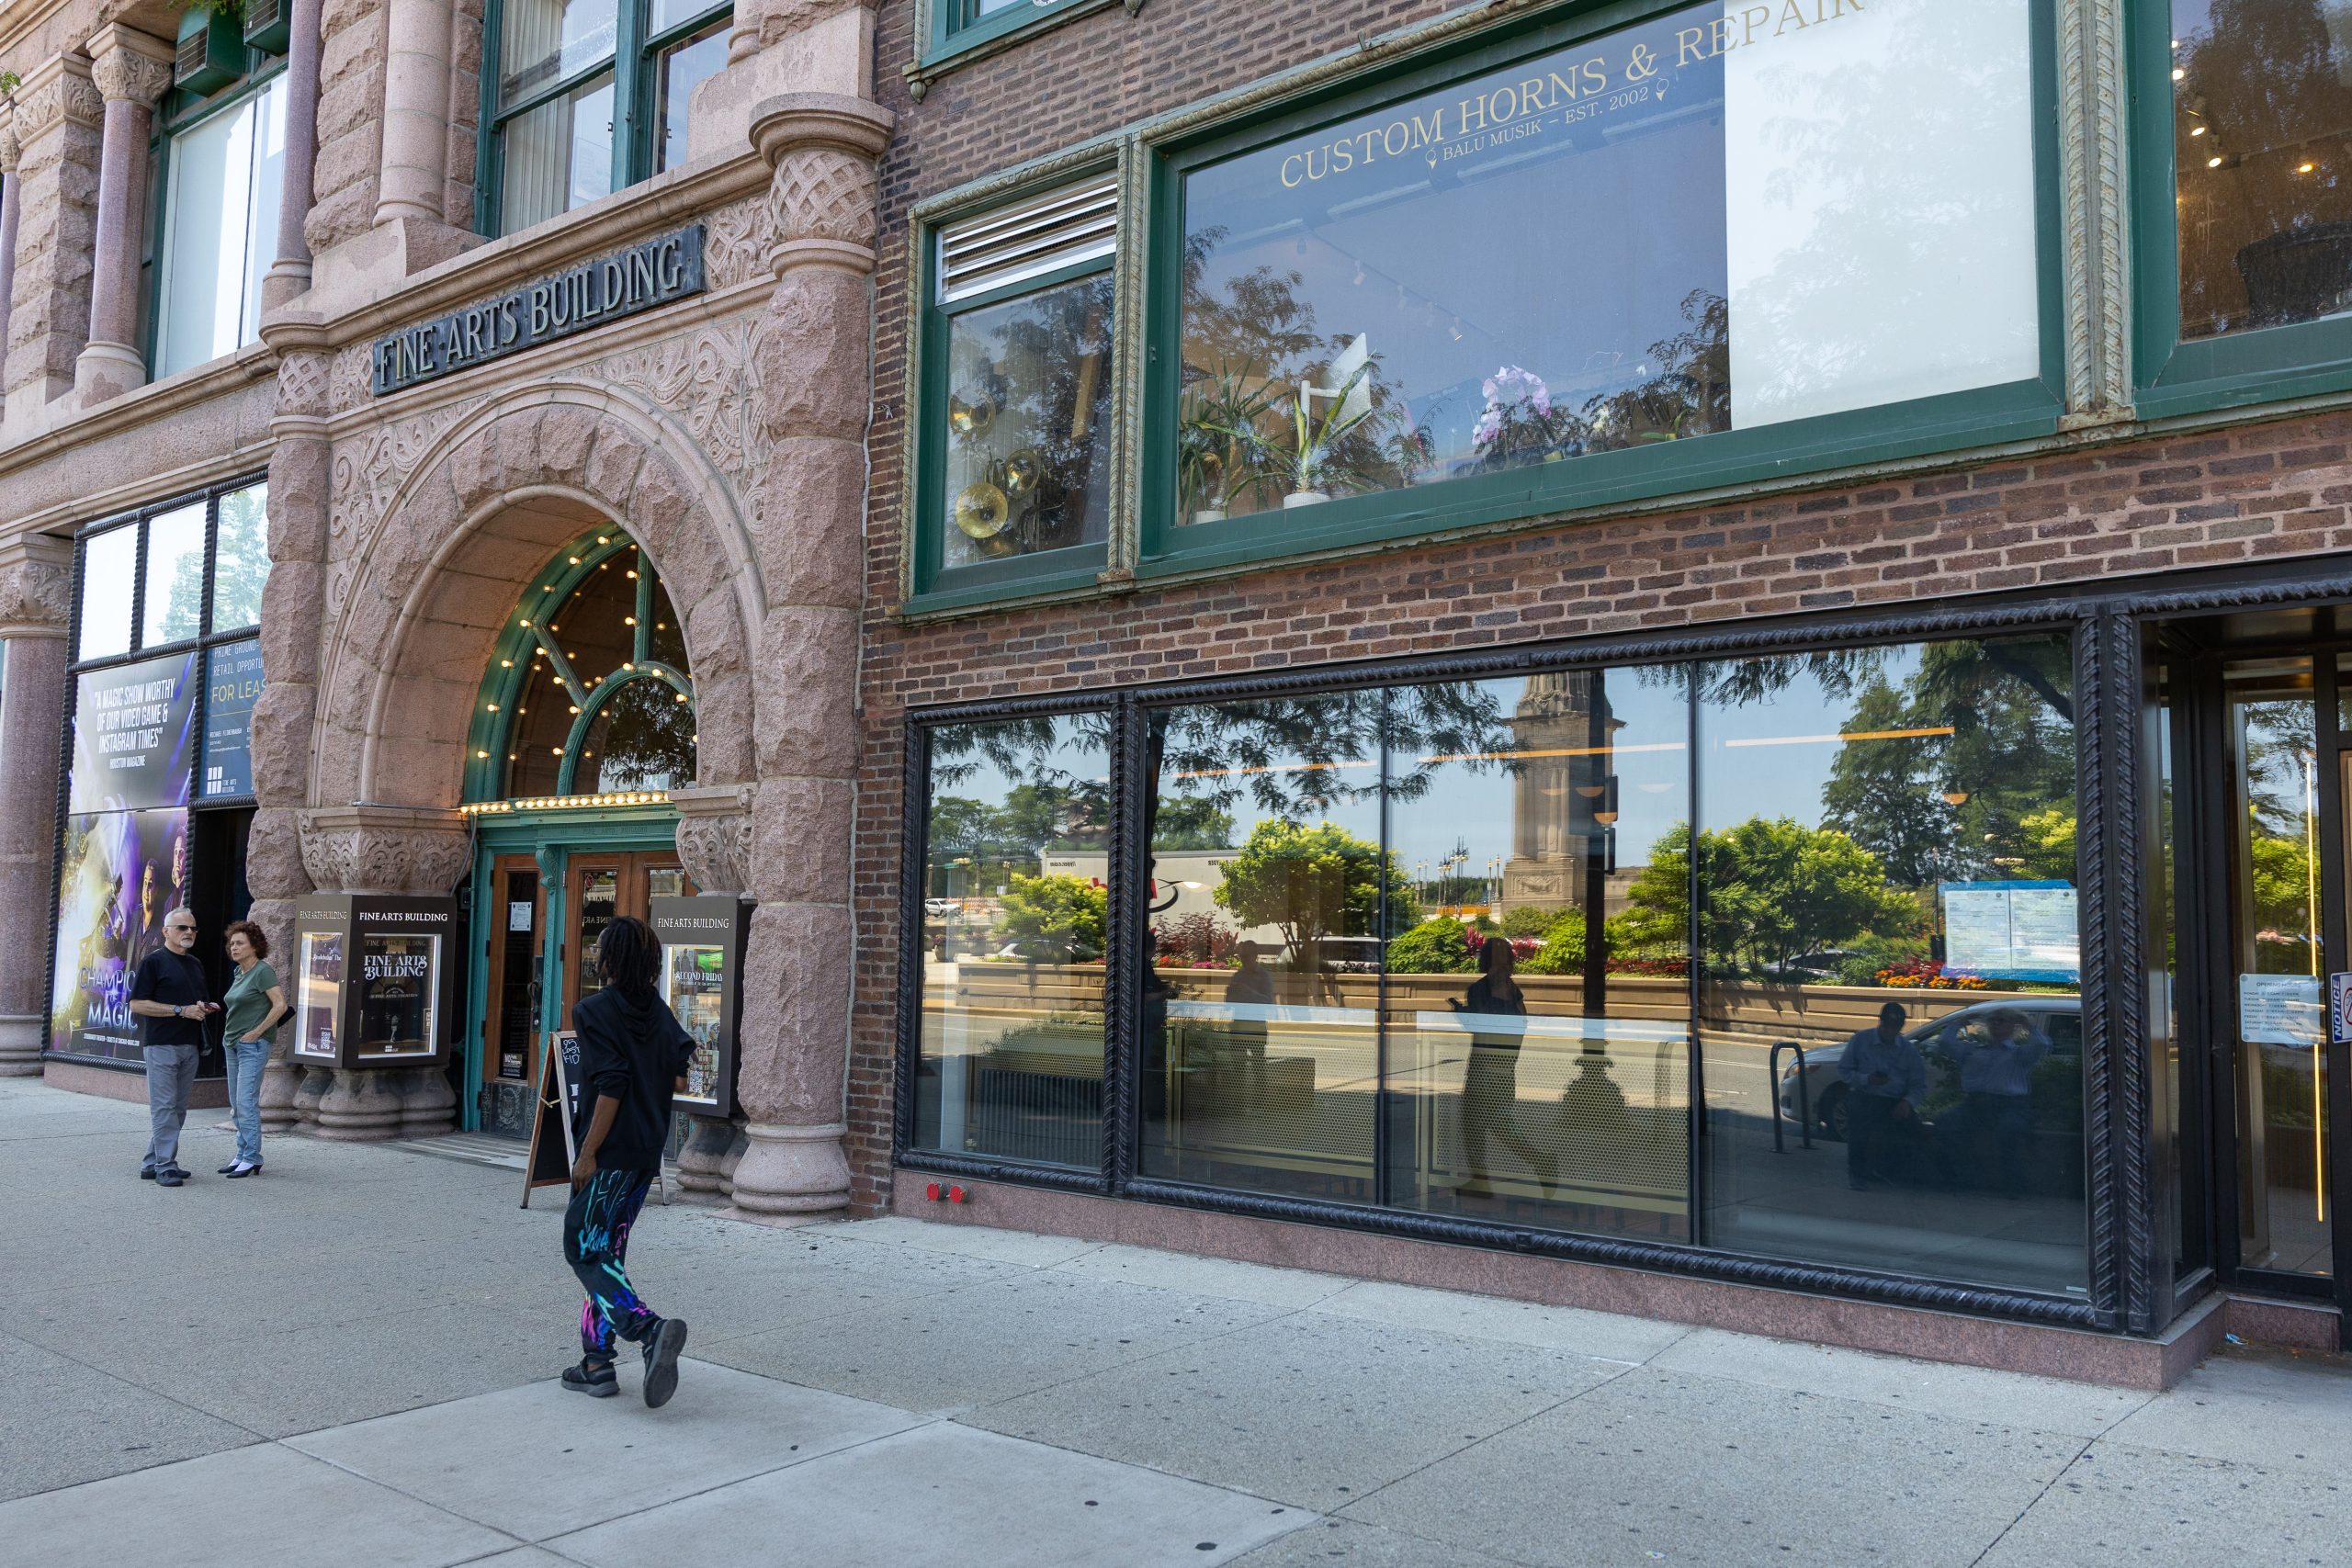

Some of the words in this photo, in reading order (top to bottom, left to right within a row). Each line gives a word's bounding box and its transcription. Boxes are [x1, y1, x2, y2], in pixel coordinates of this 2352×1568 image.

[1281, 109, 1444, 188] CUSTOM
[1458, 57, 1607, 136] HORNS
[1625, 43, 1659, 82] &
[1442, 138, 1485, 162] BALU
[1489, 118, 1542, 147] MUSIK
[1565, 103, 1603, 127] EST.
[1609, 86, 1649, 111] 2002
[380, 326, 436, 385] FINE
[447, 296, 520, 359] ARTS
[531, 239, 683, 335] BUILDING
[215, 645, 231, 658] PRIME
[214, 663, 233, 676] RETAIL
[102, 687, 123, 708] MAGIC
[125, 684, 145, 705] SHOW
[145, 678, 175, 701] WORTHY
[212, 684, 234, 703] FOR
[97, 711, 107, 731] OF
[107, 709, 119, 729] OUR
[121, 707, 140, 728] VIDEO
[141, 705, 161, 726] GAME
[163, 704, 168, 722] &
[99, 730, 136, 753] INSTAGRAM
[359, 912, 379, 920] FINE
[405, 913, 447, 921] BUILDING
[658, 919, 673, 927] FINE
[674, 919, 691, 927] ARTS
[694, 919, 729, 928] BUILDING
[365, 955, 391, 965] FINE
[395, 955, 427, 968] ARTS
[365, 966, 424, 980] BUILDING
[675, 971, 700, 981] SECOND
[88, 999, 138, 1030] MAGIC
[2333, 979, 2341, 1036] NOTICE
